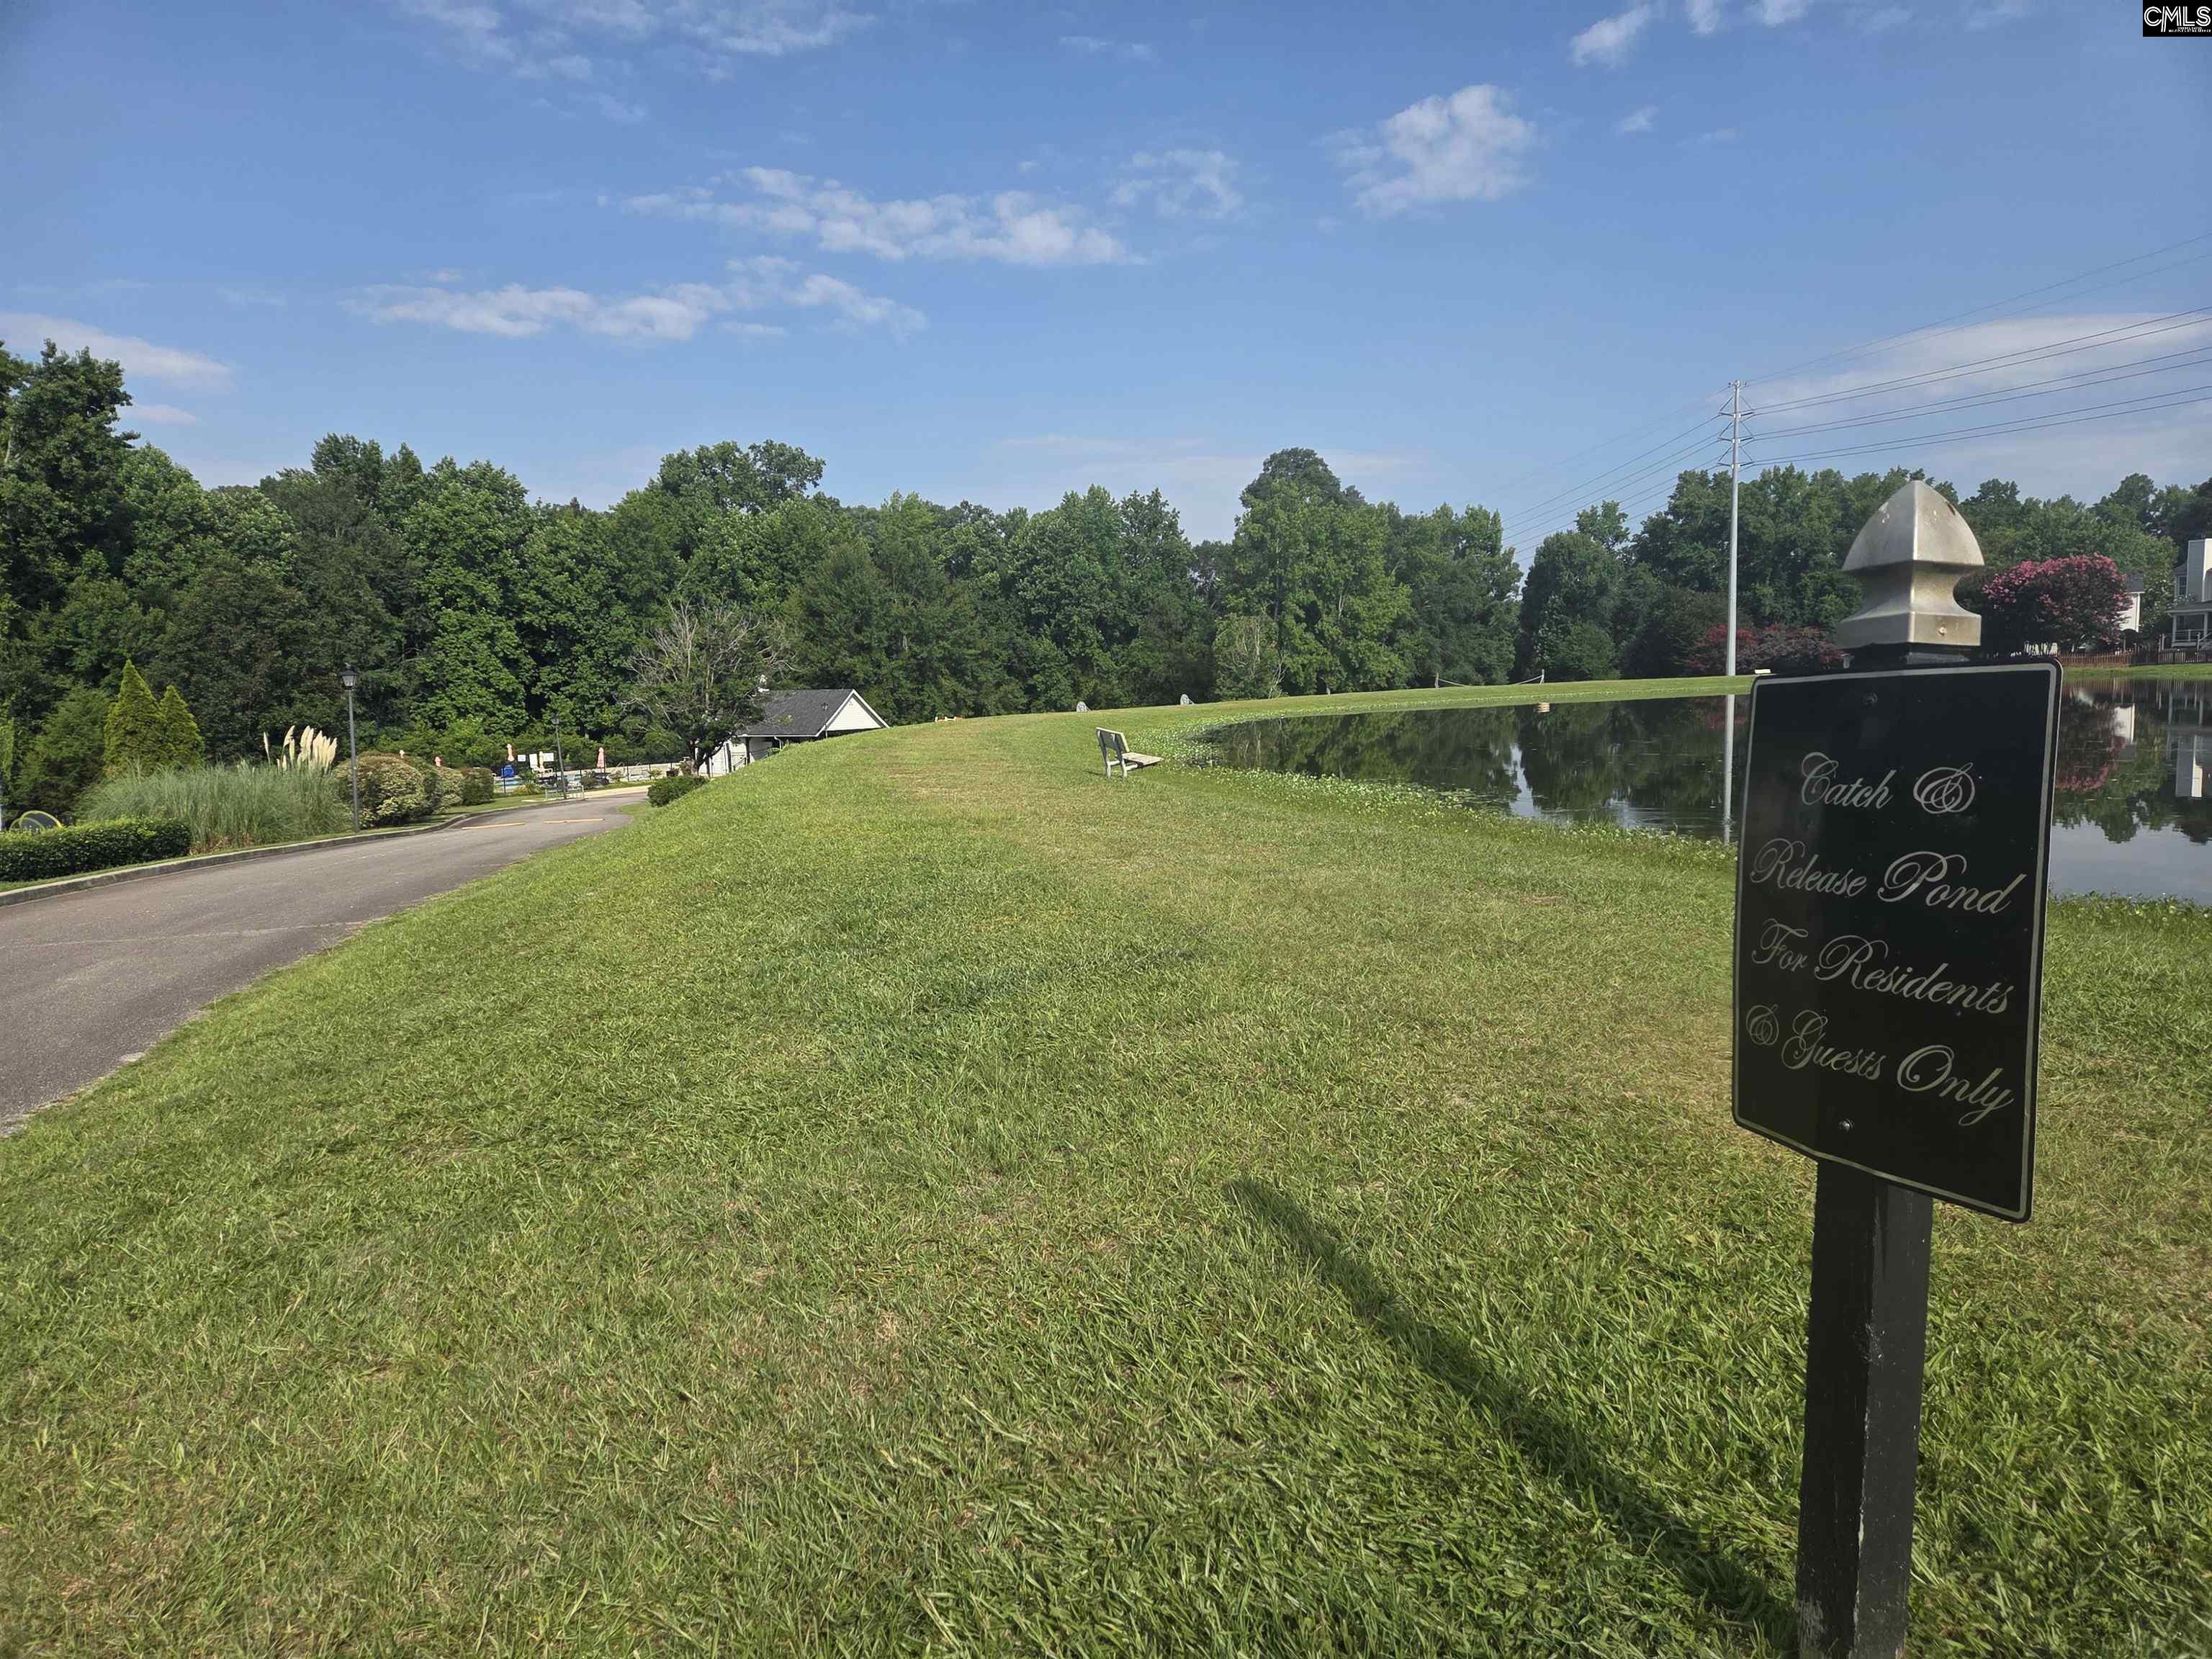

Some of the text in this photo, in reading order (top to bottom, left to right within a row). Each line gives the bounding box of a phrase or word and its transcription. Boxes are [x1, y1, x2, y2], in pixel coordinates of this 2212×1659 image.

[1802, 752, 1975, 814] Catch &
[1750, 838, 2027, 914] Release Pond
[1752, 919, 2014, 1014] For Residents
[1746, 1004, 2014, 1125] & Guests Only
